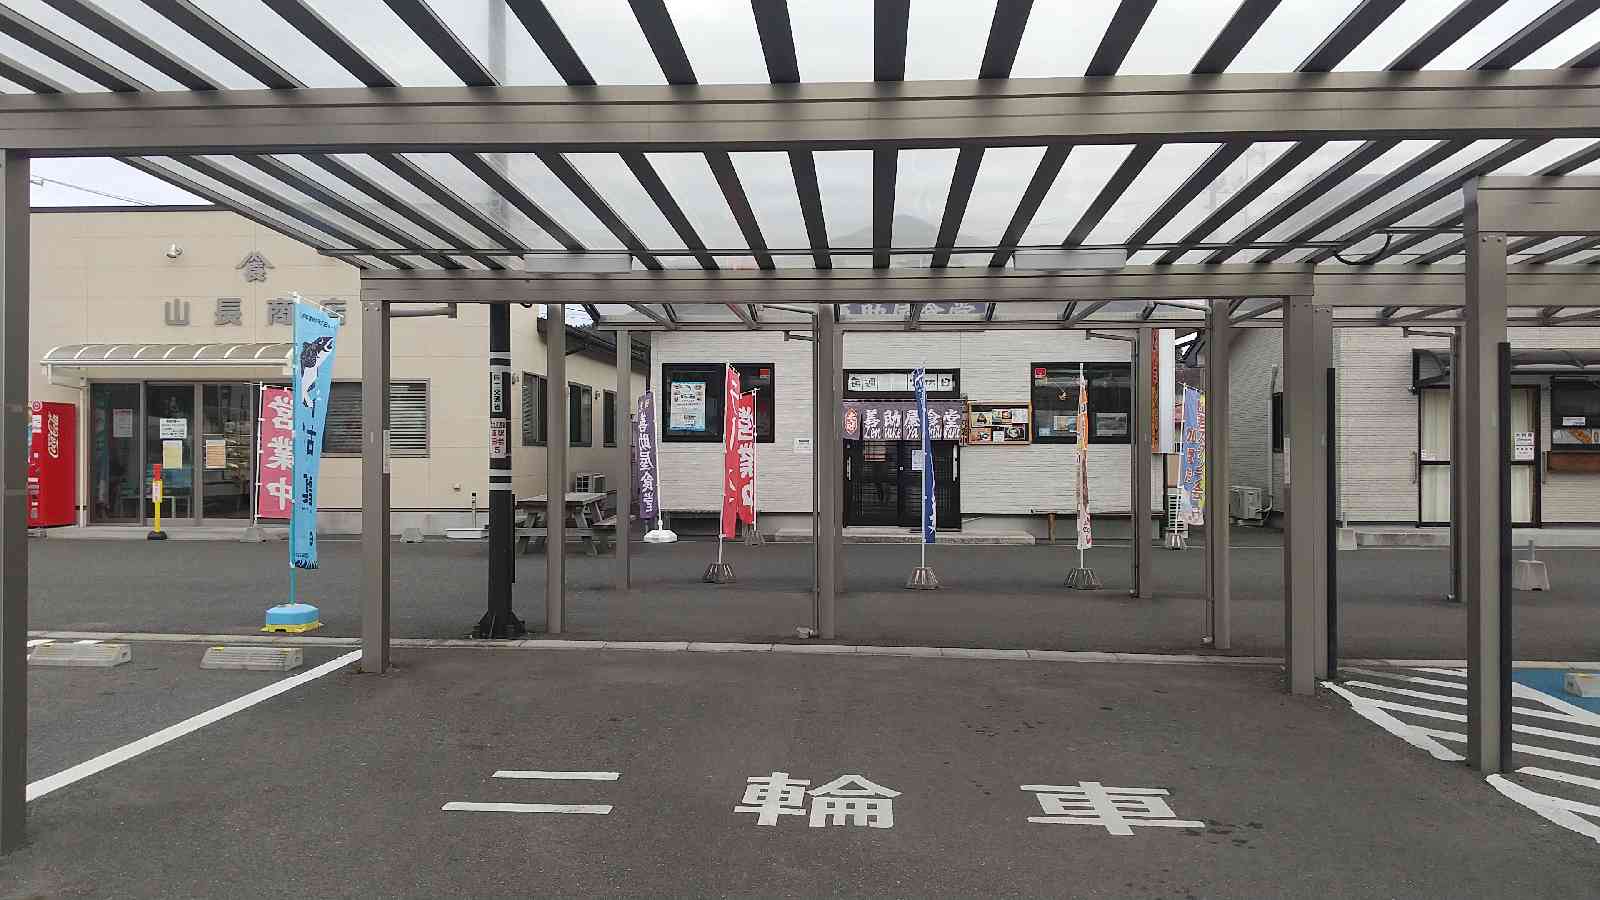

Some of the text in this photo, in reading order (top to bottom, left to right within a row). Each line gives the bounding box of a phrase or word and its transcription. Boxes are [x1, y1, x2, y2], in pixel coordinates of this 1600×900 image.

[47, 413, 60, 459] Coca-Cola
[441, 769, 1205, 836] 二輪車
